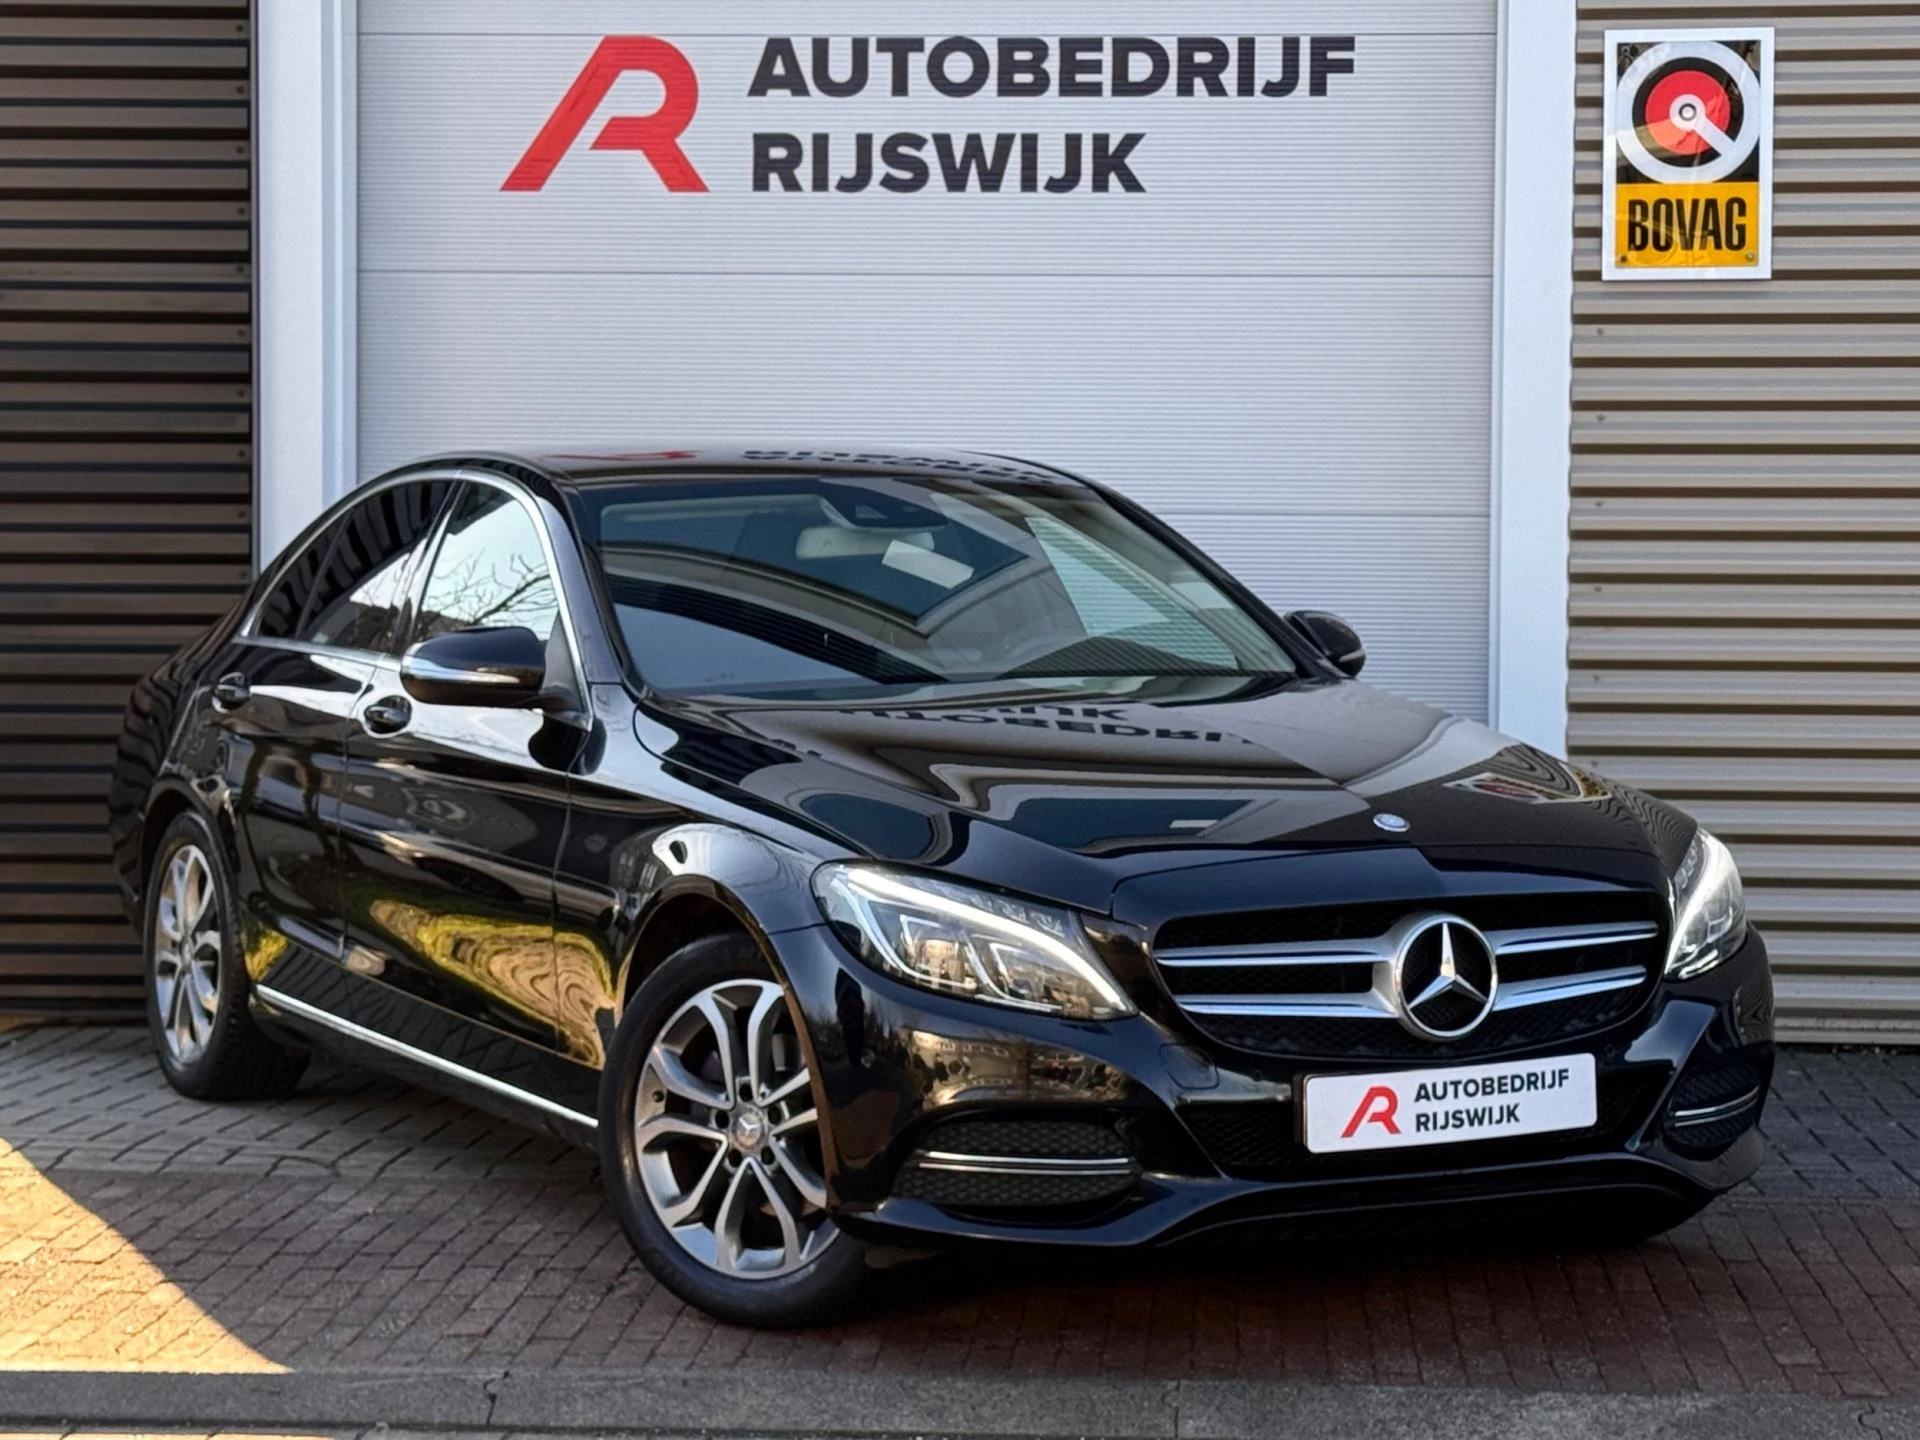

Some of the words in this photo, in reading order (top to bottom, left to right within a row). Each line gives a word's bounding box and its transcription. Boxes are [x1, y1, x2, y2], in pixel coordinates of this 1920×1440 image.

[747, 36, 1356, 97] AUTOBEDRIJF
[752, 132, 1147, 193] RIJSWIJK
[1627, 196, 1748, 252] BOVAG
[1414, 1068, 1570, 1103] AUTOBEDRIJF
[1415, 1103, 1521, 1133] RIJSWIJK
